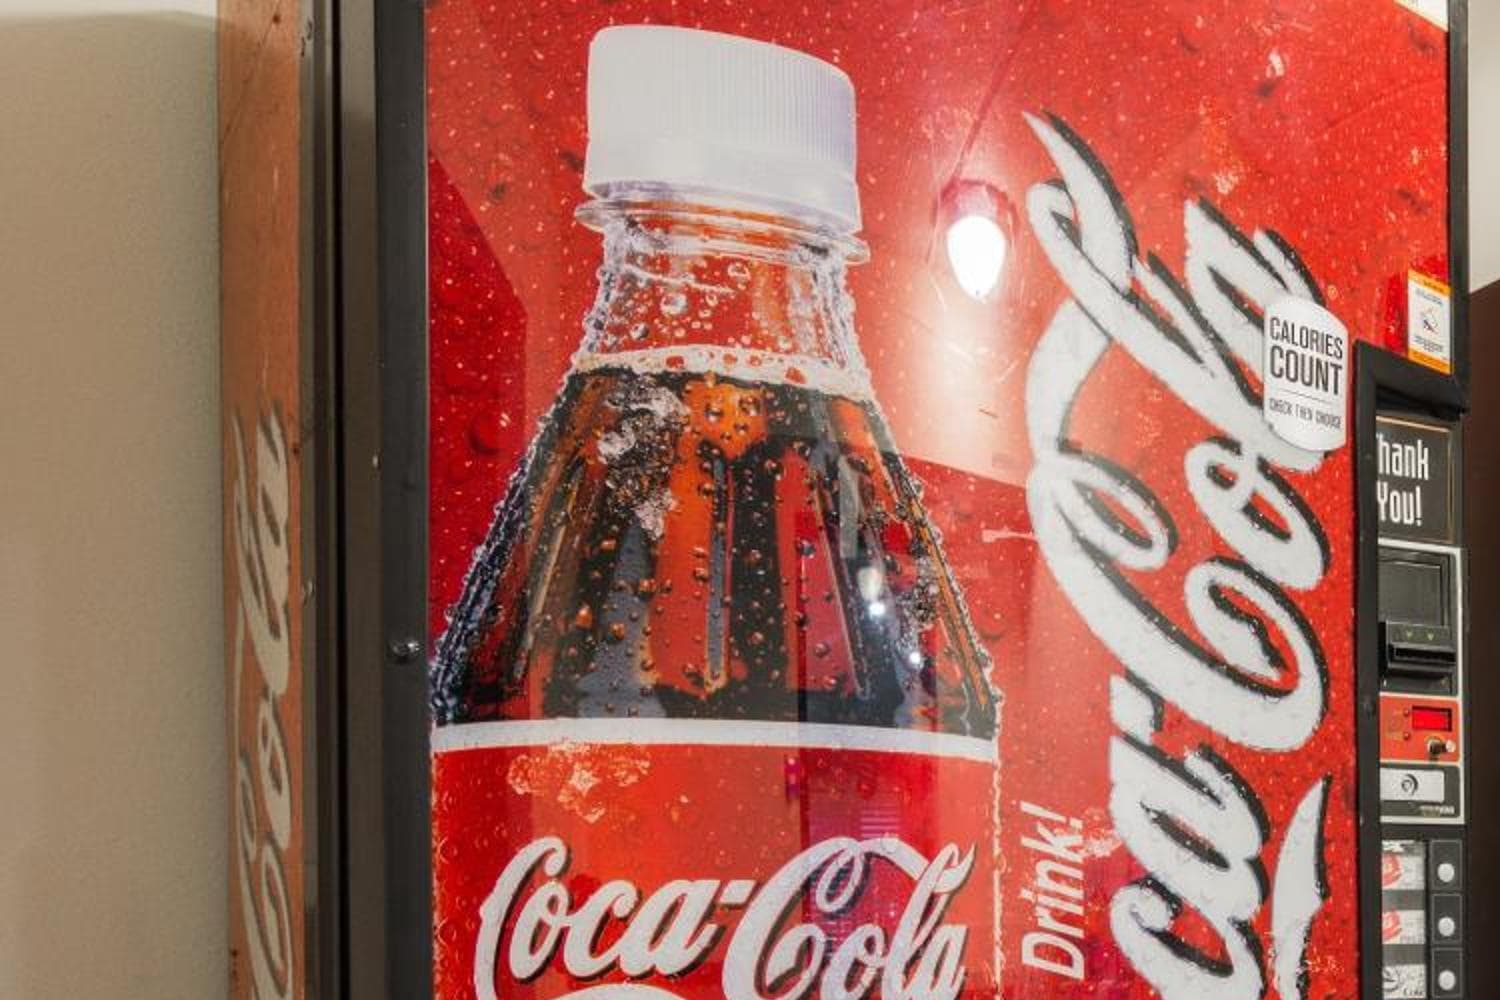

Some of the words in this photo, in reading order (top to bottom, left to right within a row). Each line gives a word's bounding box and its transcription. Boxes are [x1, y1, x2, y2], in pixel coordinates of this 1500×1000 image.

[1270, 317, 1343, 360] CALORIES
[1270, 345, 1343, 396] COUNT
[1269, 397, 1293, 416] CHECK
[1375, 481, 1423, 527] You!
[1020, 801, 1087, 981] Drink!
